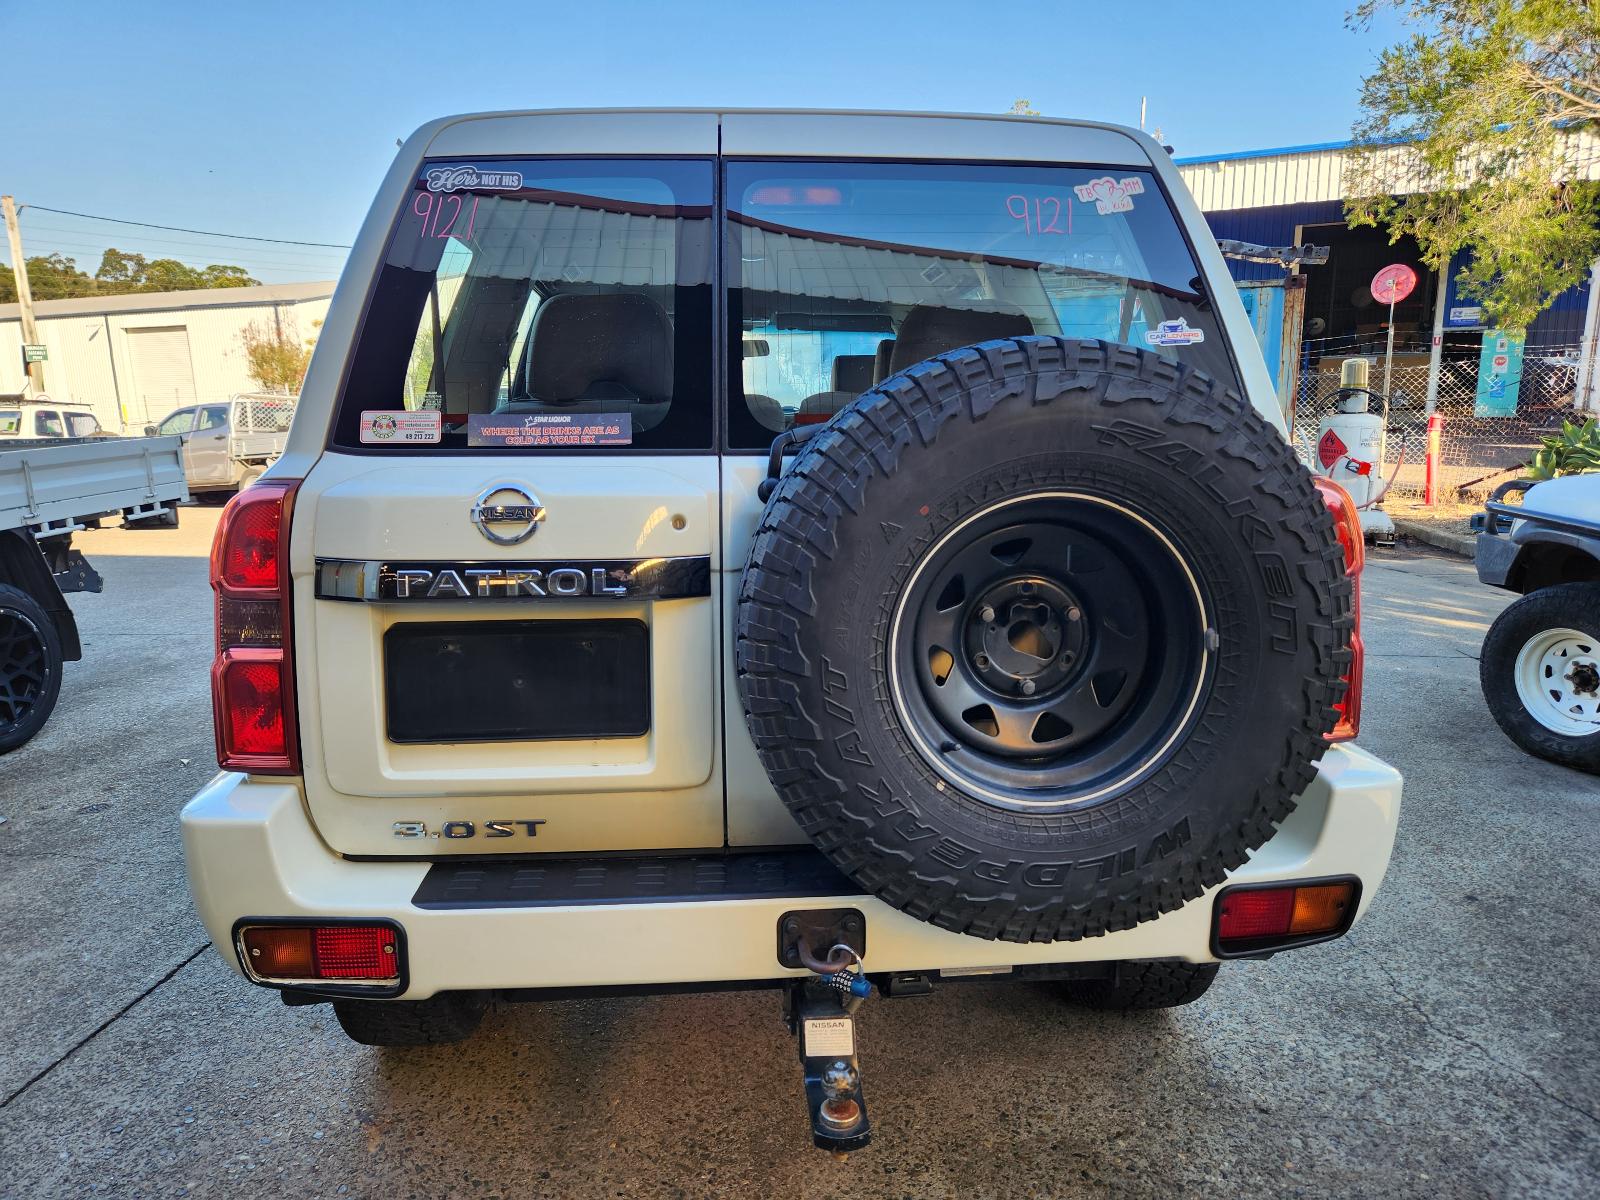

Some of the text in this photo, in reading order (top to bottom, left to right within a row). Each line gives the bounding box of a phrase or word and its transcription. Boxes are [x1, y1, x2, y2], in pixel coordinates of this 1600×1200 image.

[431, 168, 519, 189] Hers NOT HIS
[414, 192, 479, 240] 9121
[1006, 195, 1073, 236] 9121
[480, 425, 620, 436] WHERE THE DRINKS ARE AS
[506, 435, 596, 445] COLD AS YOUR EX
[479, 507, 537, 519] NISSAN
[396, 567, 628, 597] PATROL
[391, 818, 547, 840] 3.0 ST
[811, 1021, 845, 1029] NISSAN
